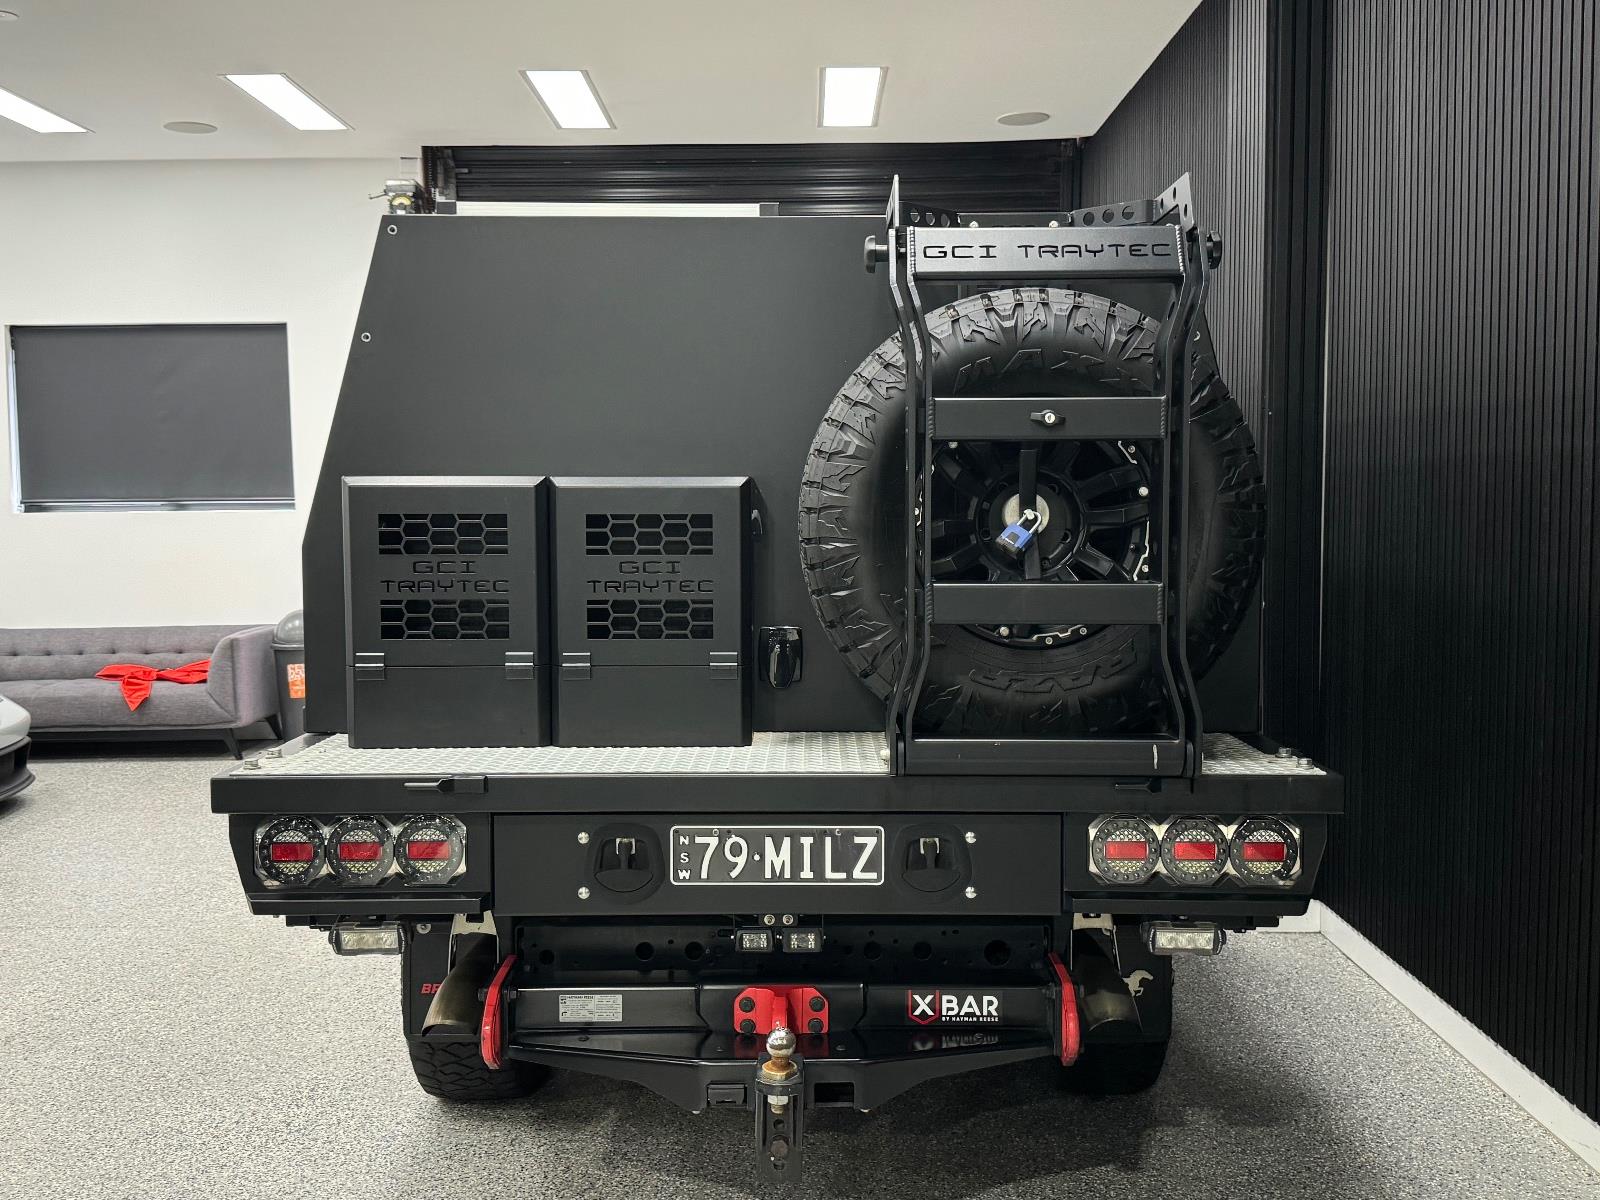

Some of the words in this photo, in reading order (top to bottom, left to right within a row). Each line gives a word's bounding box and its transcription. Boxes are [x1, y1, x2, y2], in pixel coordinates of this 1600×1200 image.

[923, 245, 998, 259] GCI
[1017, 243, 1172, 258] TRAYTEC
[412, 560, 477, 574] GCI
[618, 560, 681, 574] GCI
[380, 579, 510, 593] TRAYTEC
[587, 579, 714, 593] TRAYTEC
